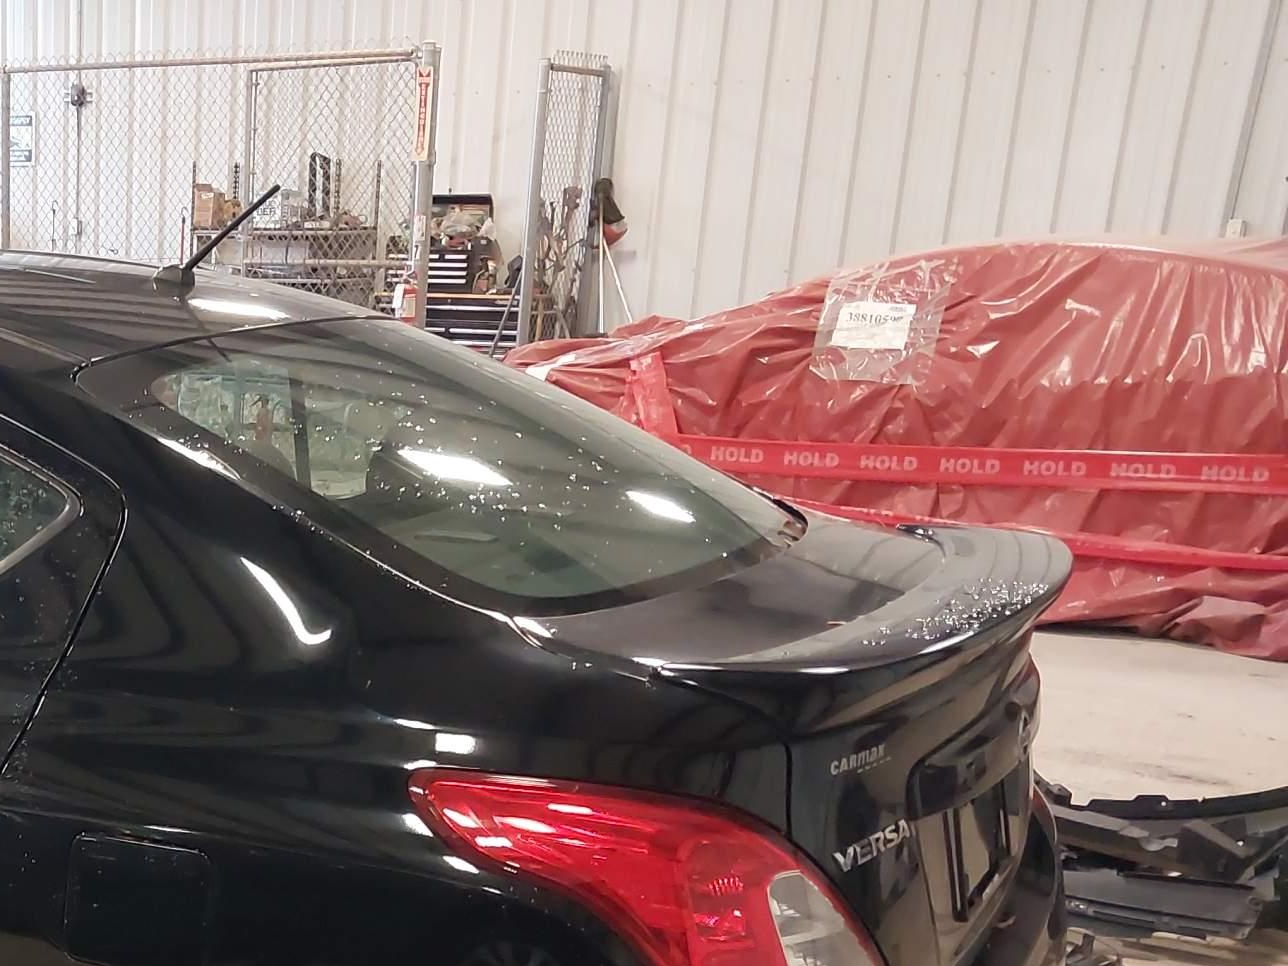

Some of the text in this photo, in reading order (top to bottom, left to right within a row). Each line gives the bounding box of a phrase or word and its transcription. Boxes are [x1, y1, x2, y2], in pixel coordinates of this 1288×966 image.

[710, 446, 764, 463] HOLD
[783, 451, 840, 468] HOLD
[860, 455, 918, 471] HOLD
[939, 458, 1001, 474] HOLD
[1023, 460, 1087, 477] HOLD
[1110, 463, 1176, 479] HOLD
[1200, 465, 1270, 482] HOLD
[832, 819, 910, 872] VERSA
